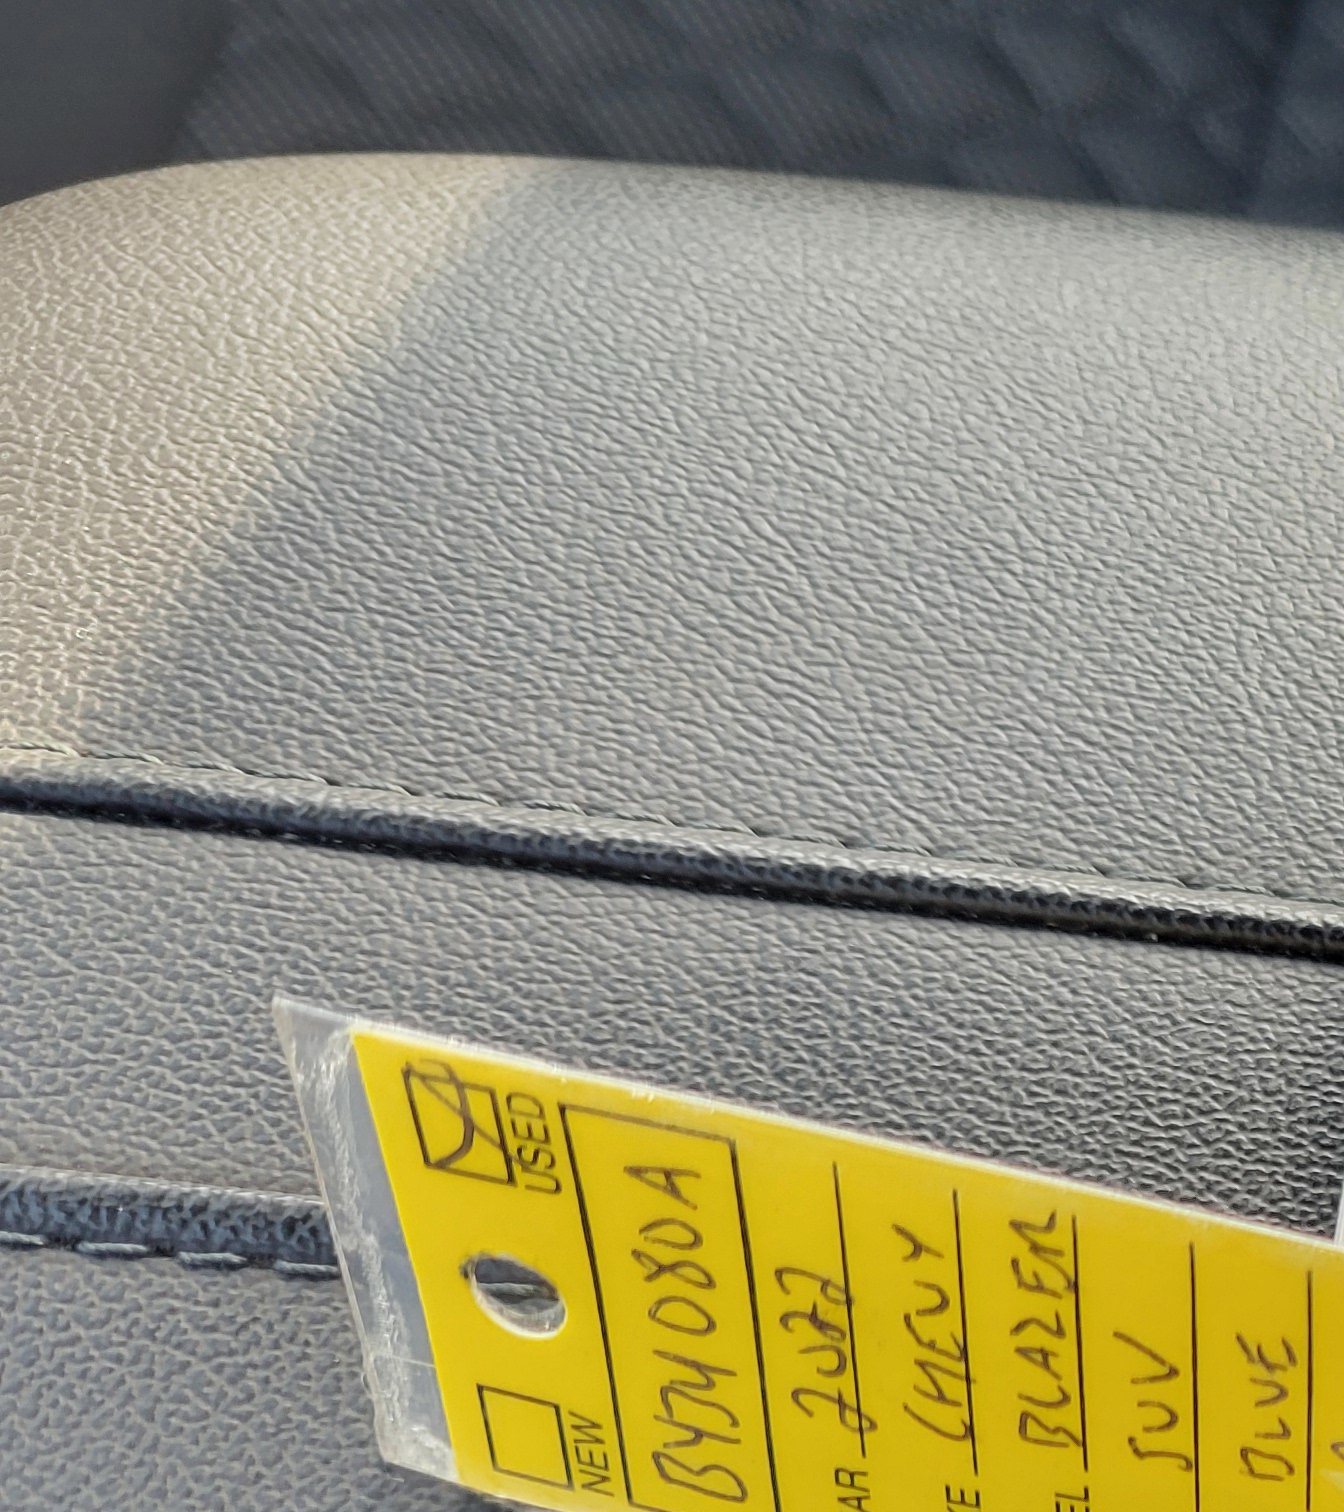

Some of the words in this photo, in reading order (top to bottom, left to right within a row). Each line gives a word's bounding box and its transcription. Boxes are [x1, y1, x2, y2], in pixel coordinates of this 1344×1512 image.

[505, 1091, 563, 1195] USED
[891, 1222, 976, 1444] CHEVY
[1112, 1331, 1194, 1472] SUV
[573, 1411, 615, 1497] NEW
[1235, 1333, 1297, 1482] BLUE
